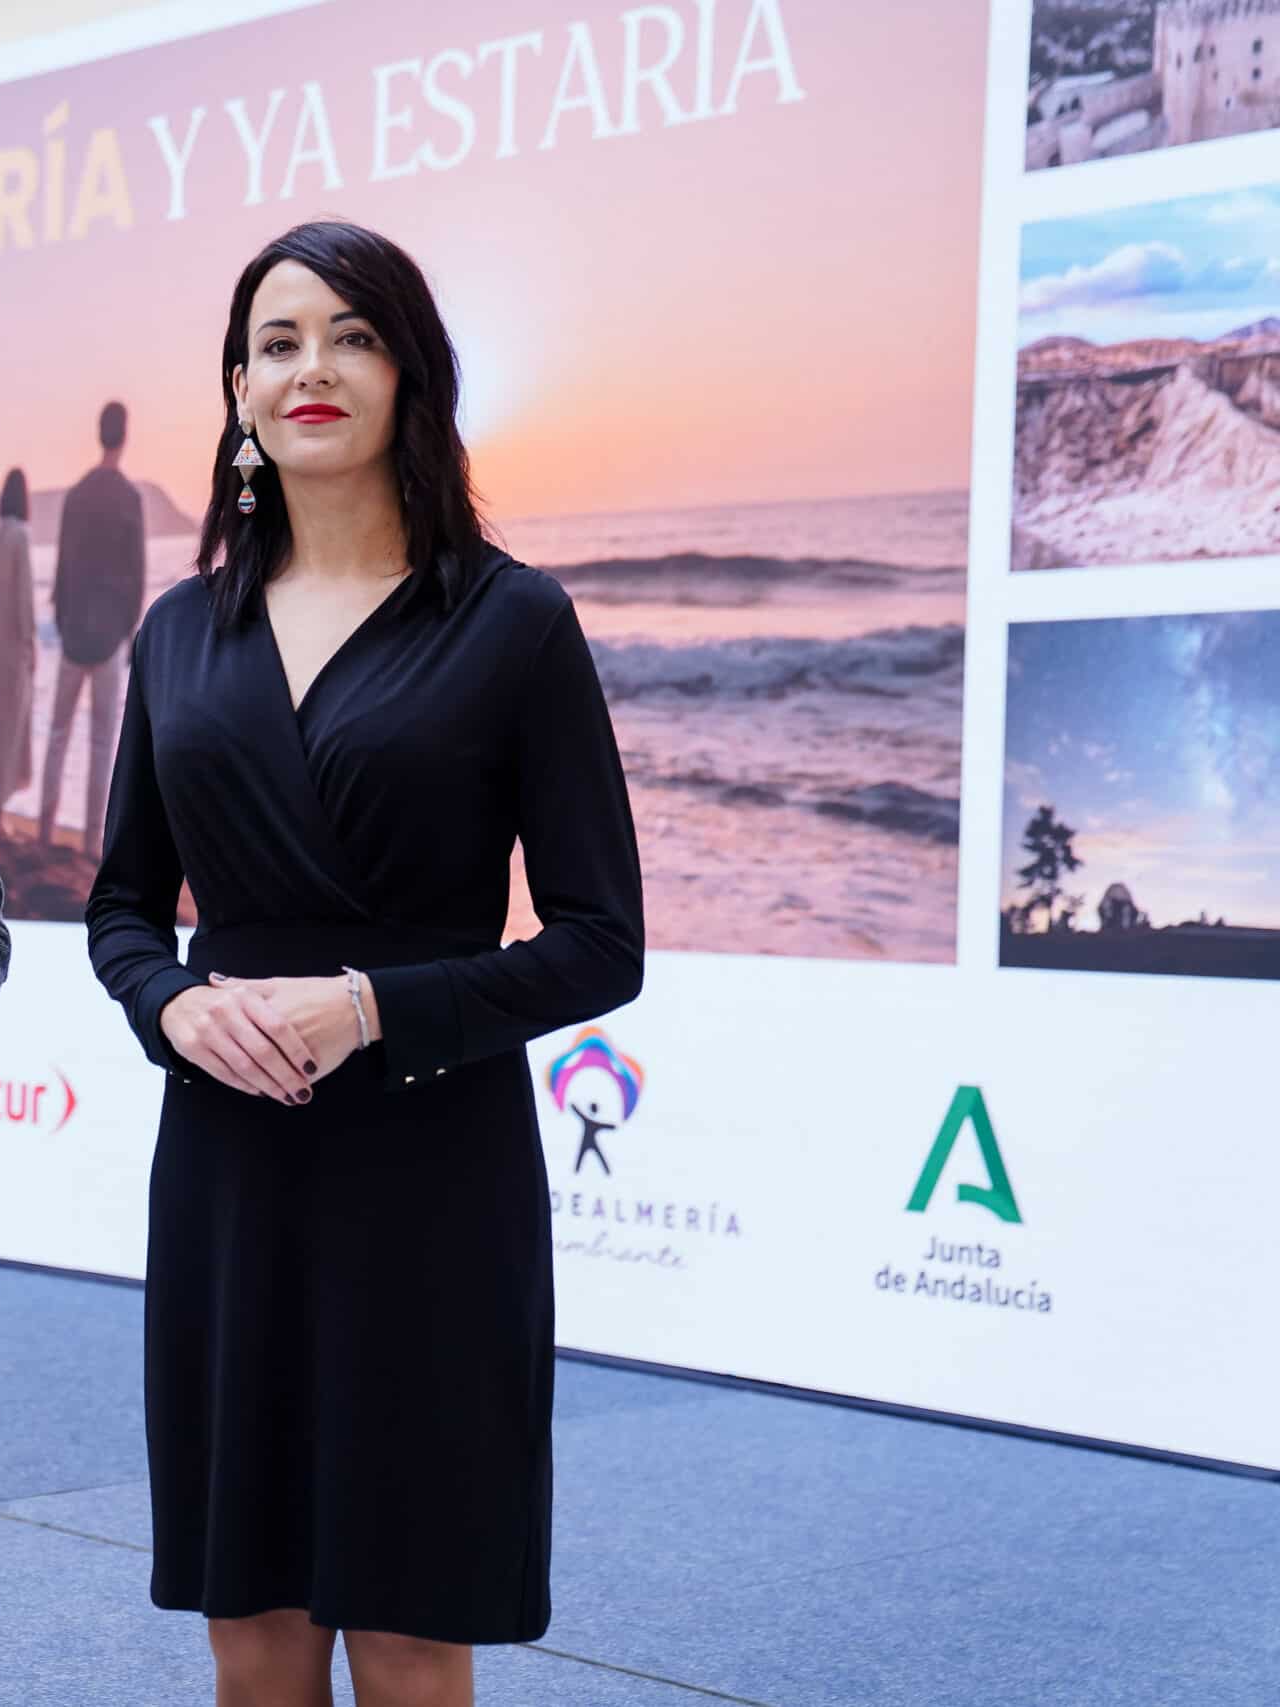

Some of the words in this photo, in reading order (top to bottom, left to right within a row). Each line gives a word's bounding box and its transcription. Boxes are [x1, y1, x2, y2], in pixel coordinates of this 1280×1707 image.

[148, 107, 207, 220] Y
[224, 81, 344, 206] YA
[924, 1237, 1001, 1268] Junta
[875, 1266, 906, 1292] de
[914, 1271, 1052, 1313] Andalucía
